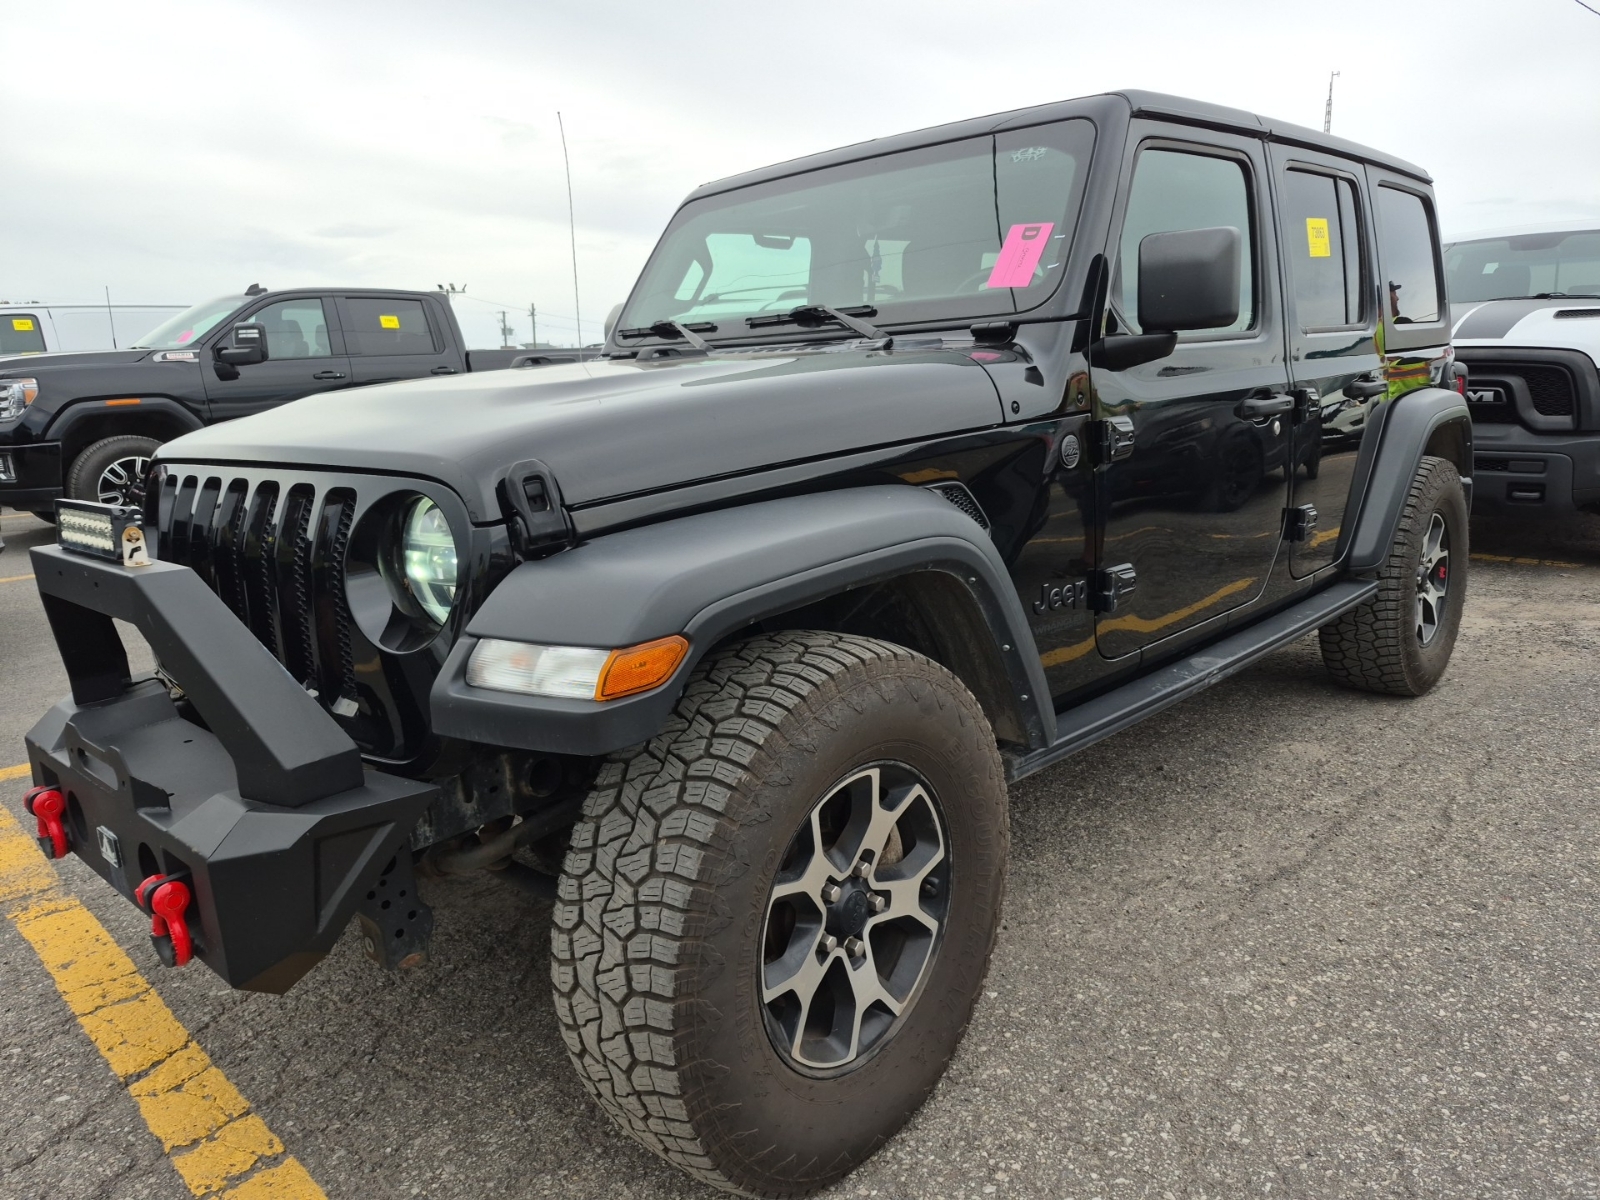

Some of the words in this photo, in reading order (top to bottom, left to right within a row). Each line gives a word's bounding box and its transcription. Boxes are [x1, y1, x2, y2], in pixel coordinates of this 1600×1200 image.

[1021, 226, 1042, 241] D
[1033, 580, 1087, 615] Jeep
[735, 848, 776, 1063] SUMITOMO
